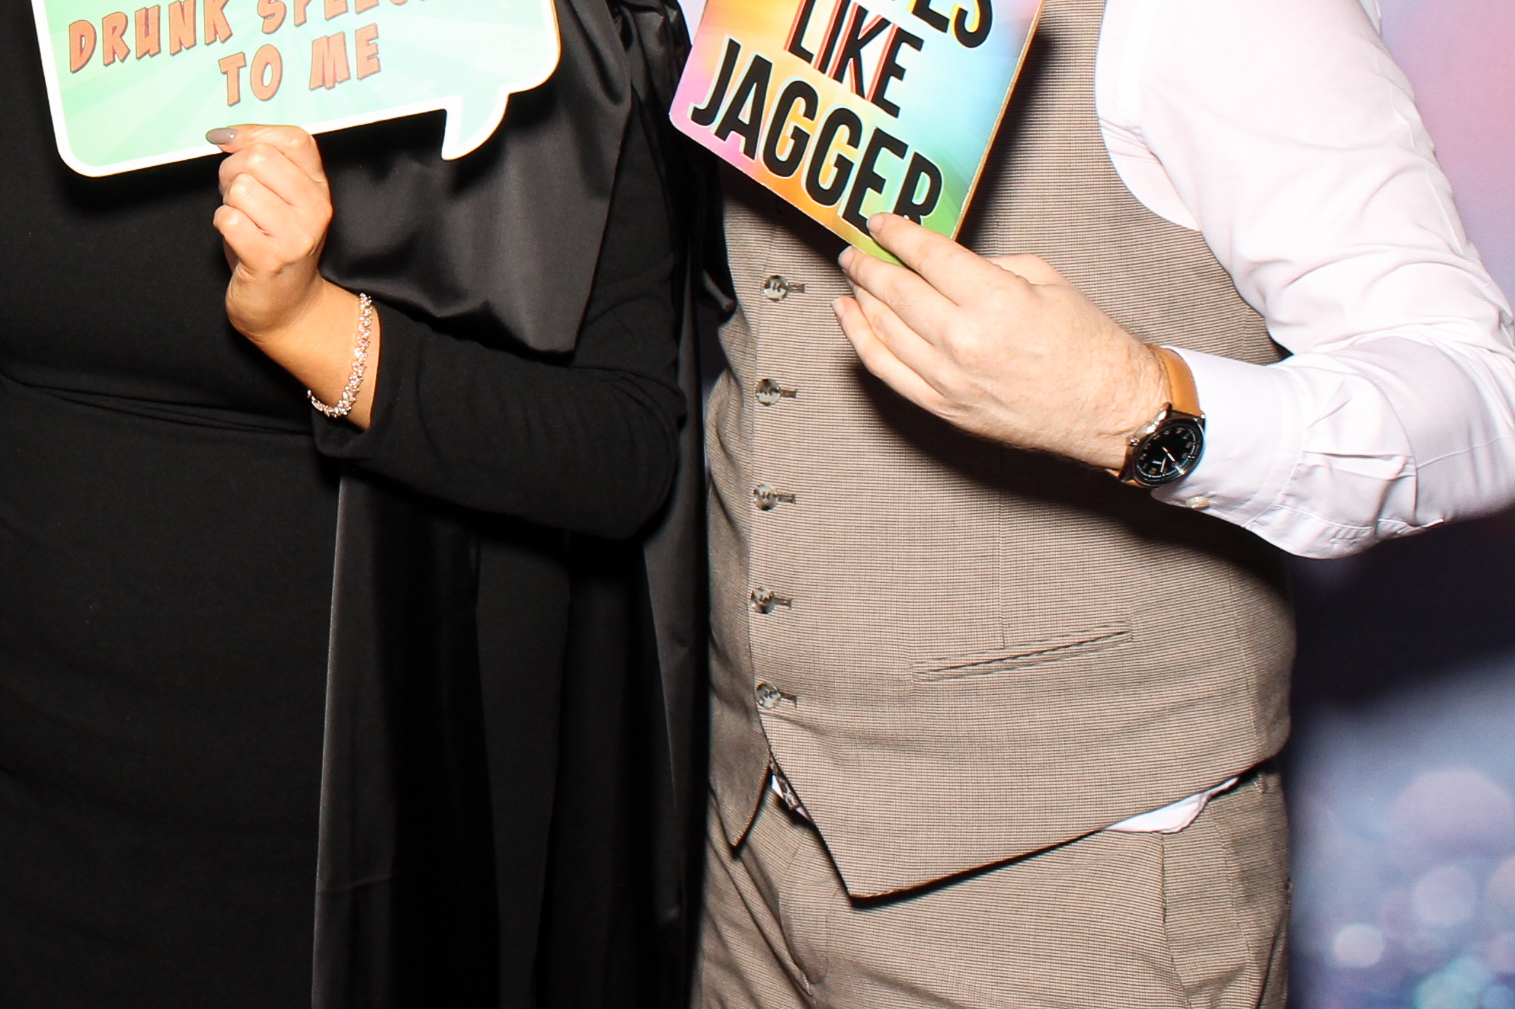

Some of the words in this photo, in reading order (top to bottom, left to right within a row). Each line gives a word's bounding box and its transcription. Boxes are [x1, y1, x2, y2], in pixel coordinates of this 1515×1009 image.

[219, 43, 283, 106] TO
[308, 23, 382, 90] ME
[689, 34, 943, 238] JAGGER
